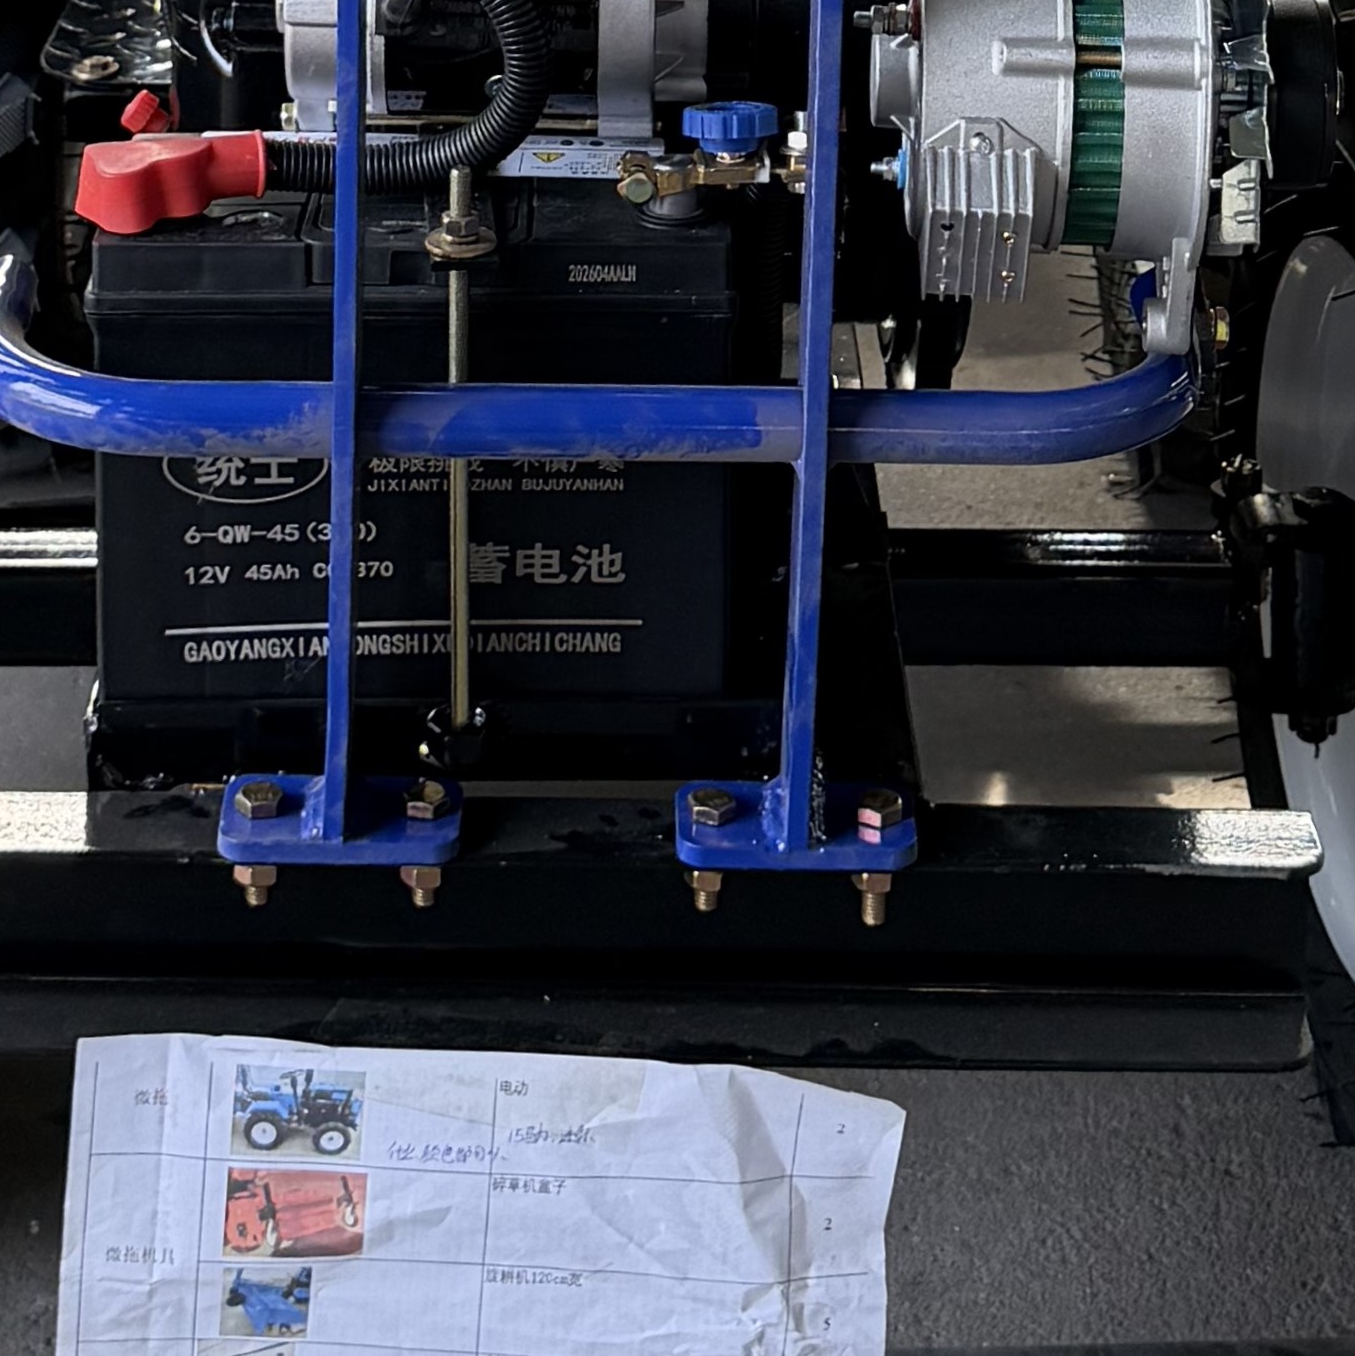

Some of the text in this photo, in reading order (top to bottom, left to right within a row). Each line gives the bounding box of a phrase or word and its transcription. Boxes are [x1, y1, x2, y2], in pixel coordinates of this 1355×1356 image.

[521, 478, 624, 491] BUJUYANHAN
[183, 565, 231, 585] 12V
[244, 563, 300, 580] 45Ah
[499, 1079, 529, 1097] 电动
[836, 1123, 846, 1134] 2
[823, 1217, 833, 1231] 2
[823, 1317, 831, 1332] 5
